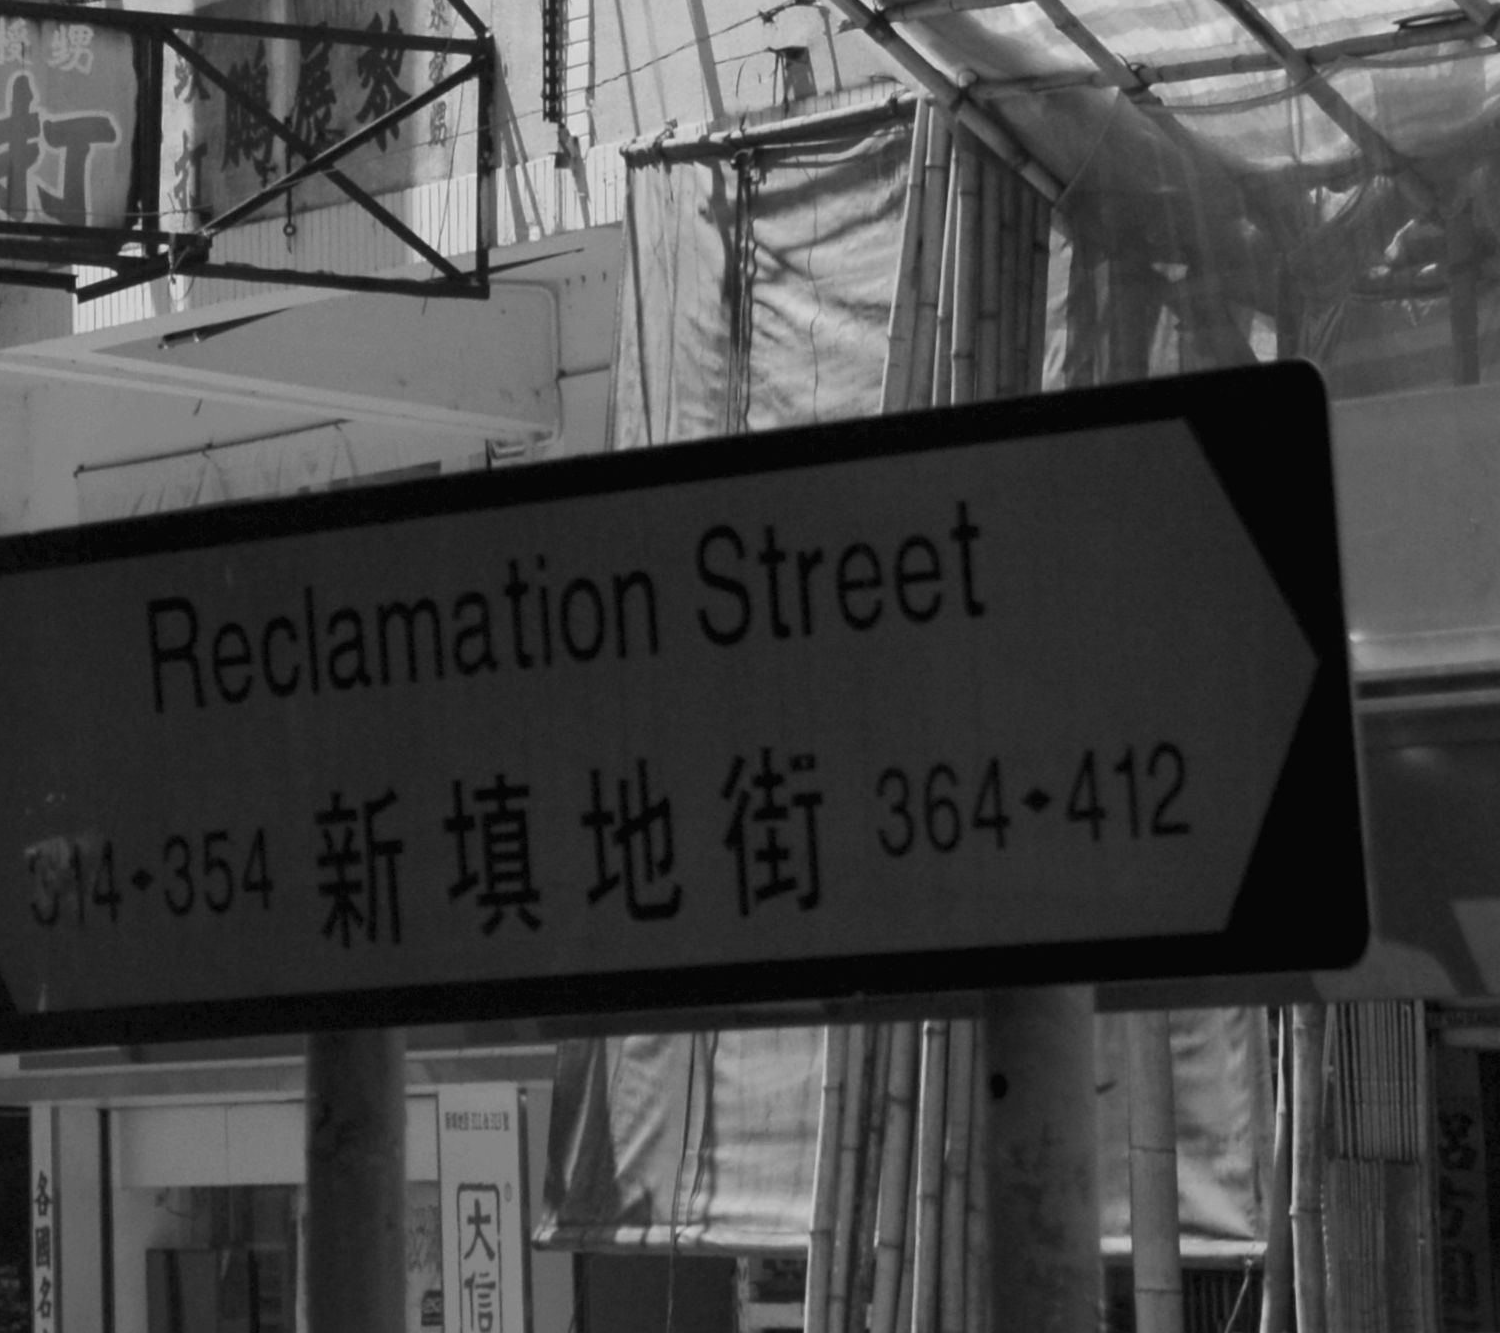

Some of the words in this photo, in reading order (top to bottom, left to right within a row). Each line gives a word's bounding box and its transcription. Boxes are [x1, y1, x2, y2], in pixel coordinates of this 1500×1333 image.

[146, 554, 660, 713] Reclamation
[698, 500, 988, 646] Street
[314, 747, 826, 949] 新填地街
[463, 1198, 497, 1333] 大信
